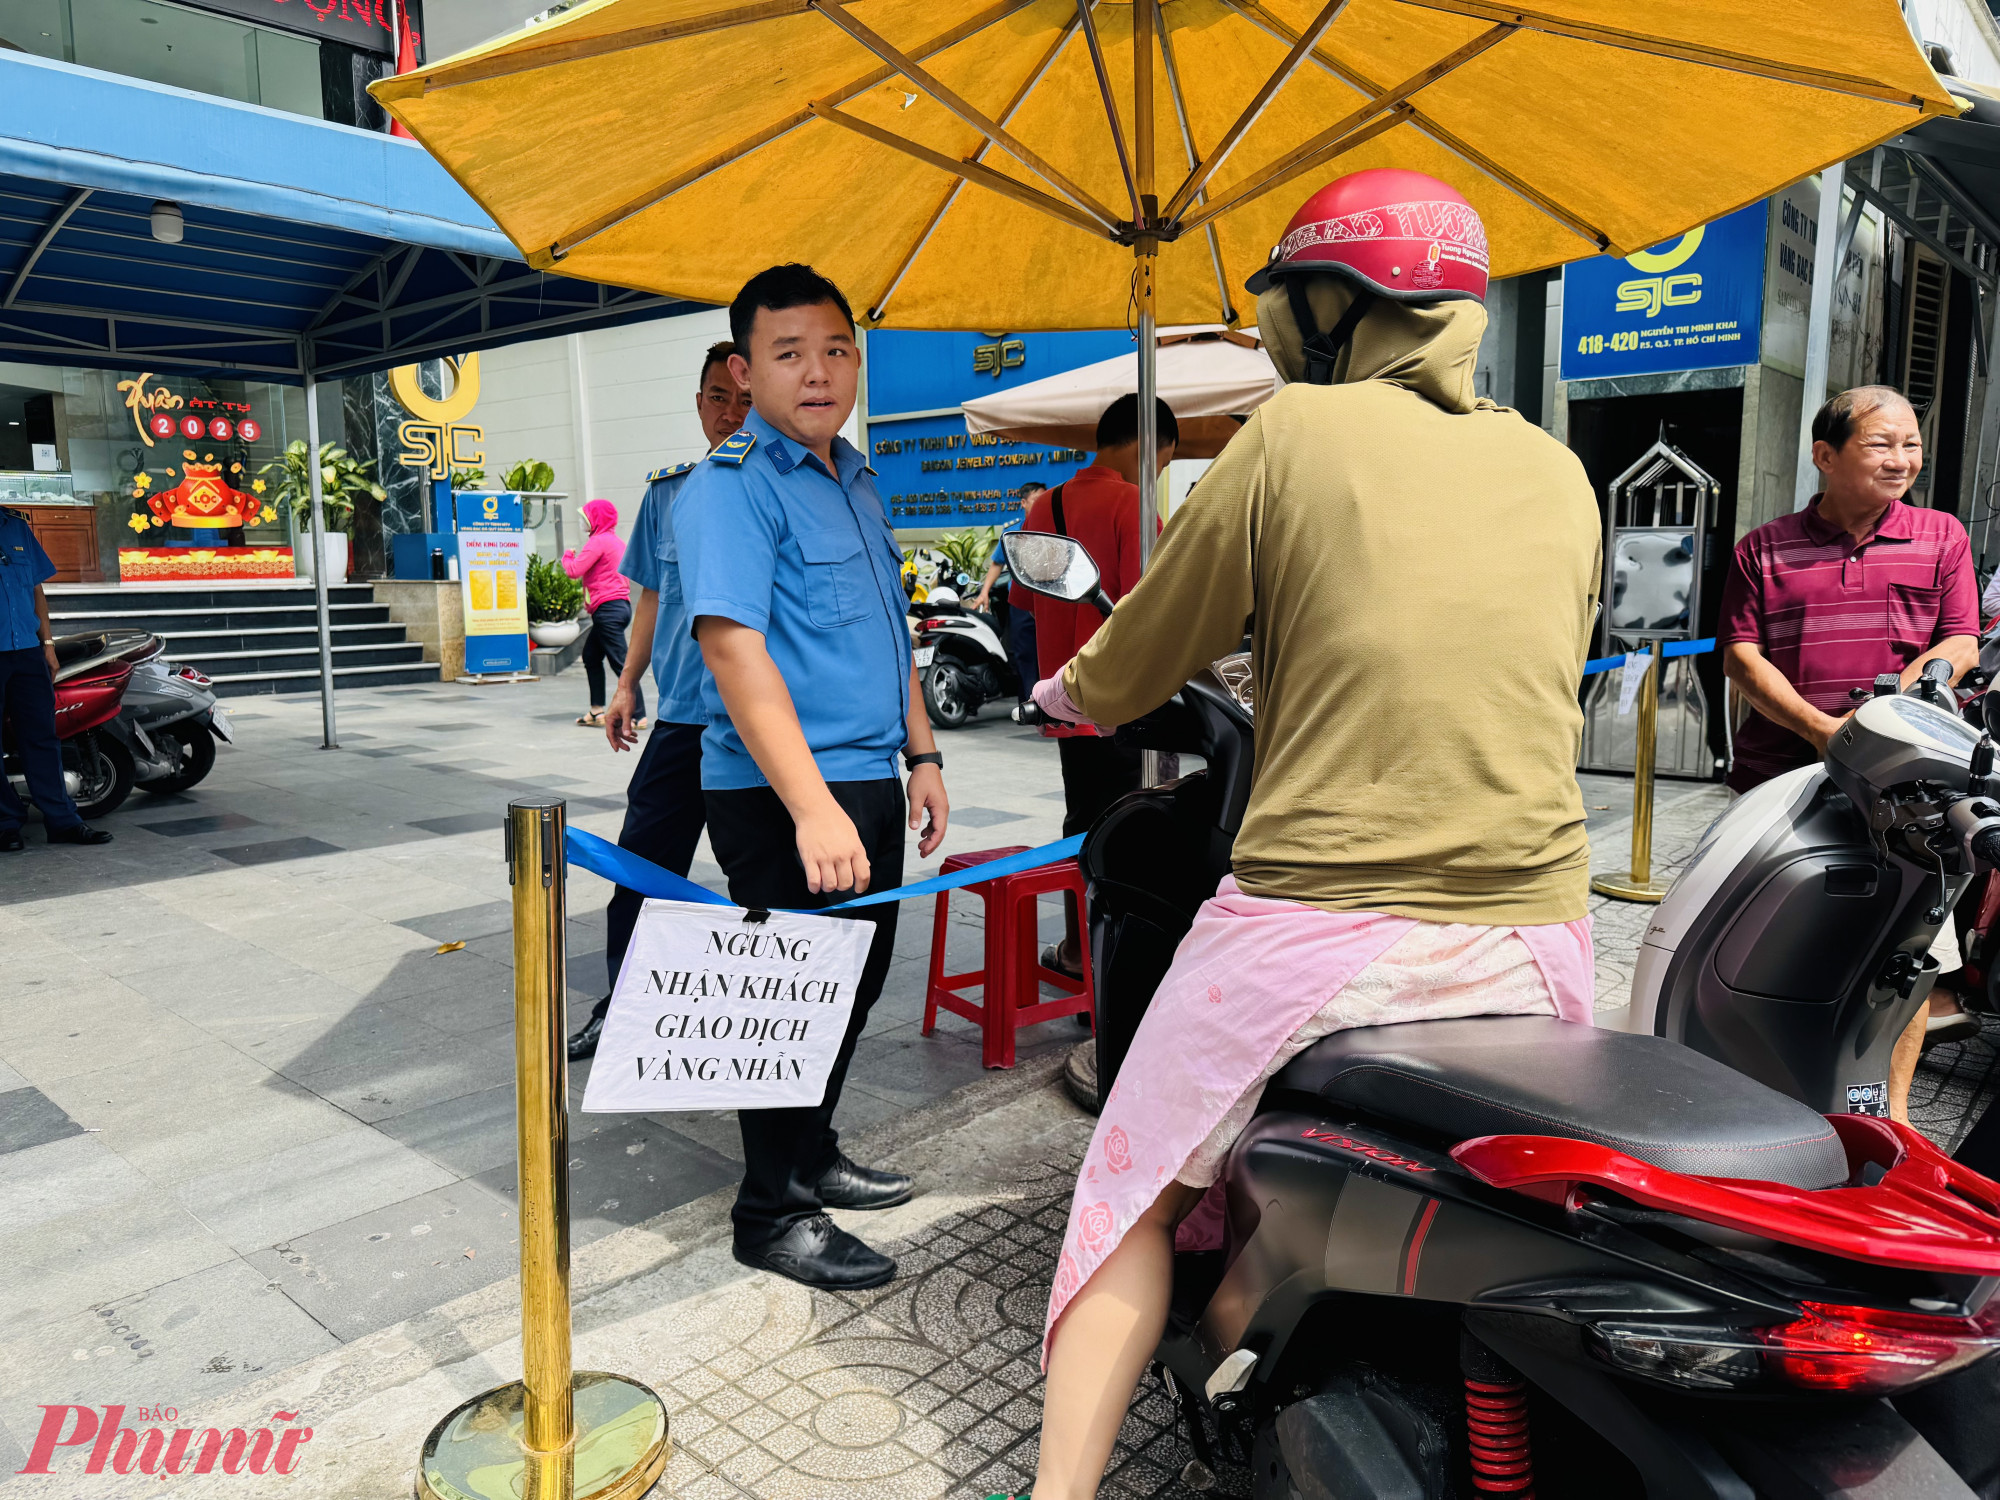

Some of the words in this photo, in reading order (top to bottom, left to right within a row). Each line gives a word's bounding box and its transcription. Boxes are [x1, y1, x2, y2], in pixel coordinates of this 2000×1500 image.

[1782, 198, 1799, 235] CÔNG
[1616, 273, 1702, 318] SJC
[1578, 331, 1638, 355] 418-420
[1691, 323, 1713, 332] MINH
[1716, 321, 1737, 330] KHAI
[1701, 333, 1716, 343] CHÍ
[1717, 332, 1741, 342] MINH
[973, 339, 1025, 377] SJC
[398, 421, 486, 480] SJC
[956, 456, 996, 469] JEWELRY
[999, 452, 1043, 466] COMPANY
[705, 931, 811, 961] NGƯNG
[644, 968, 734, 1003] NHẬN
[739, 971, 840, 1004] KHÁCH
[655, 1014, 732, 1039] GIAO
[739, 1017, 810, 1047] DỊCH
[636, 1050, 720, 1081] VÀNG
[726, 1051, 806, 1081] NHẪN
[1301, 1128, 1436, 1172] VISION
